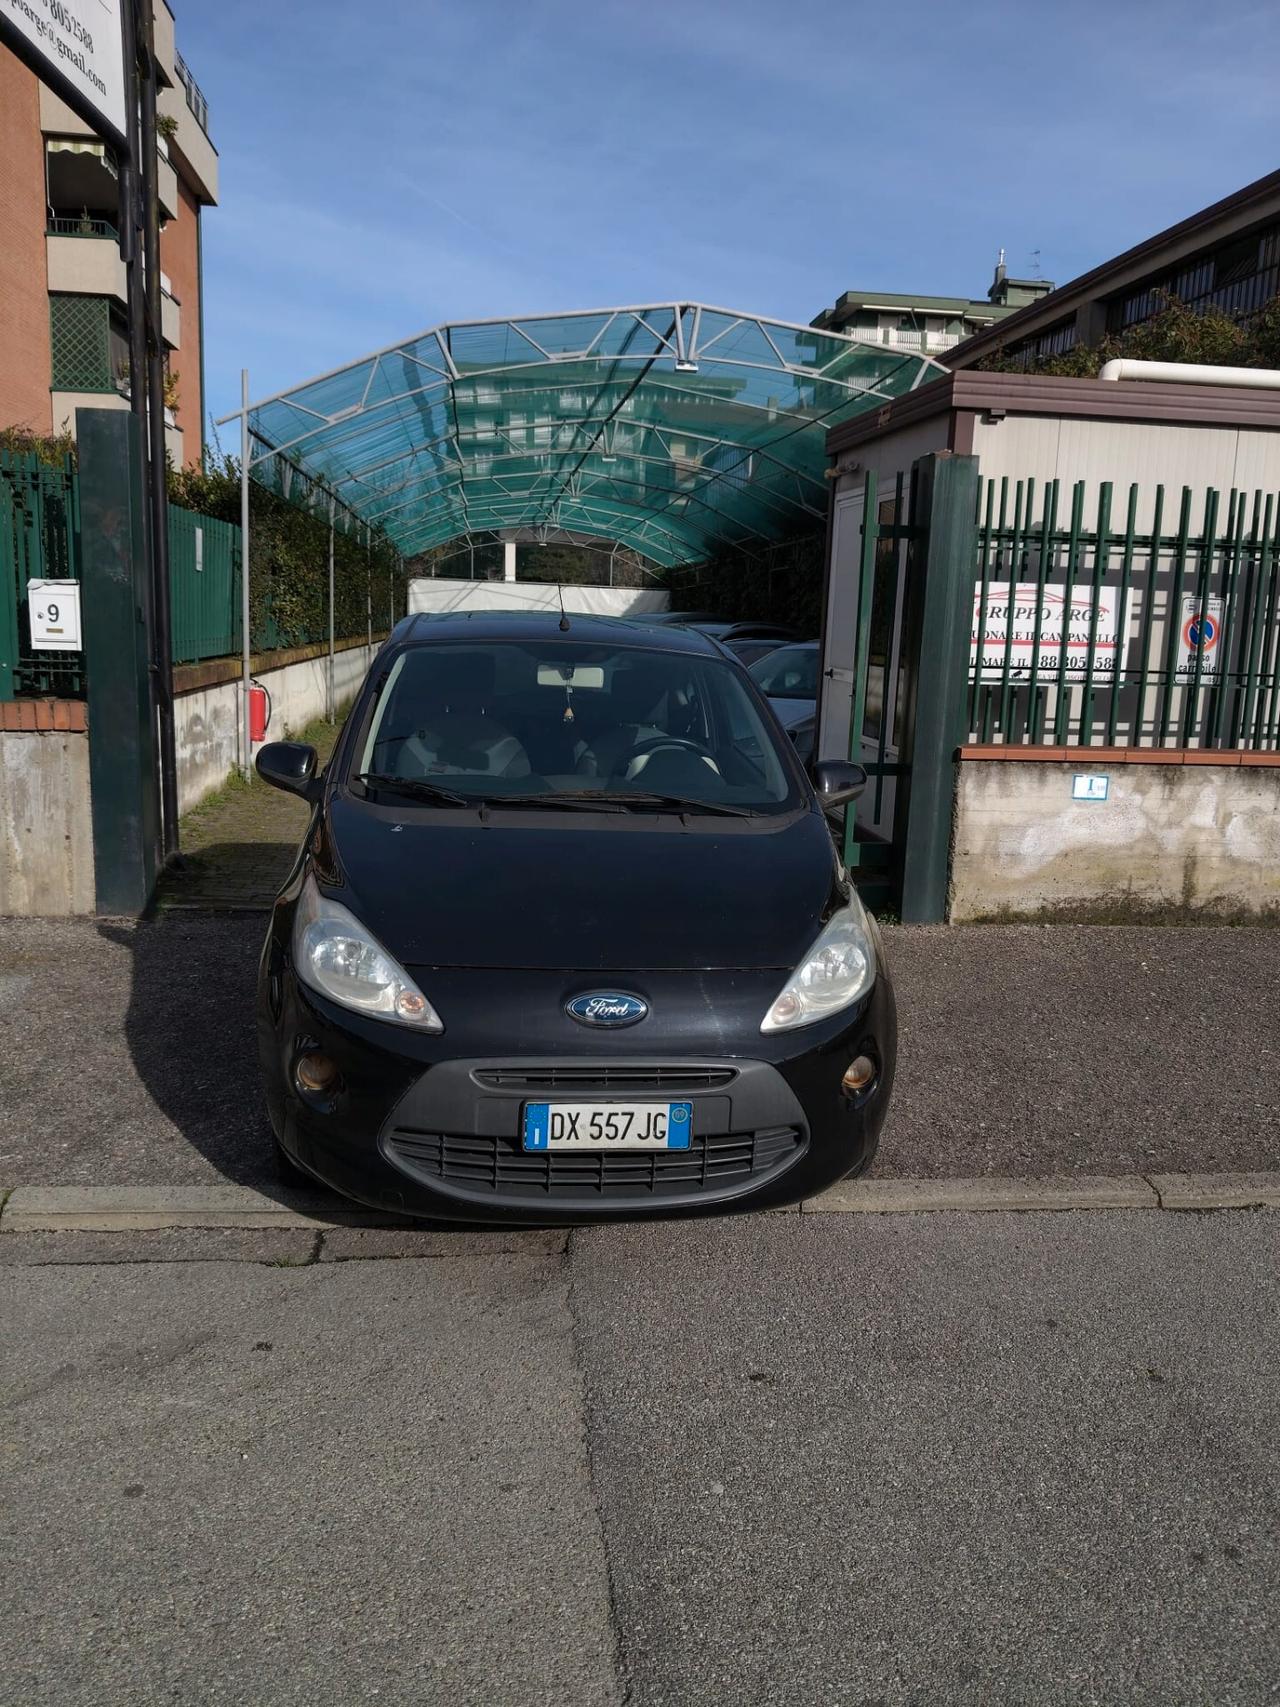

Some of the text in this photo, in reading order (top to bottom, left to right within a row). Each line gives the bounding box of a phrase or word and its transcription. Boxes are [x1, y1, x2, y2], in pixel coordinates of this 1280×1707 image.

[47, 603, 60, 623] 9
[585, 997, 629, 1016] Ford
[550, 1111, 668, 1141] DX 557 JG
